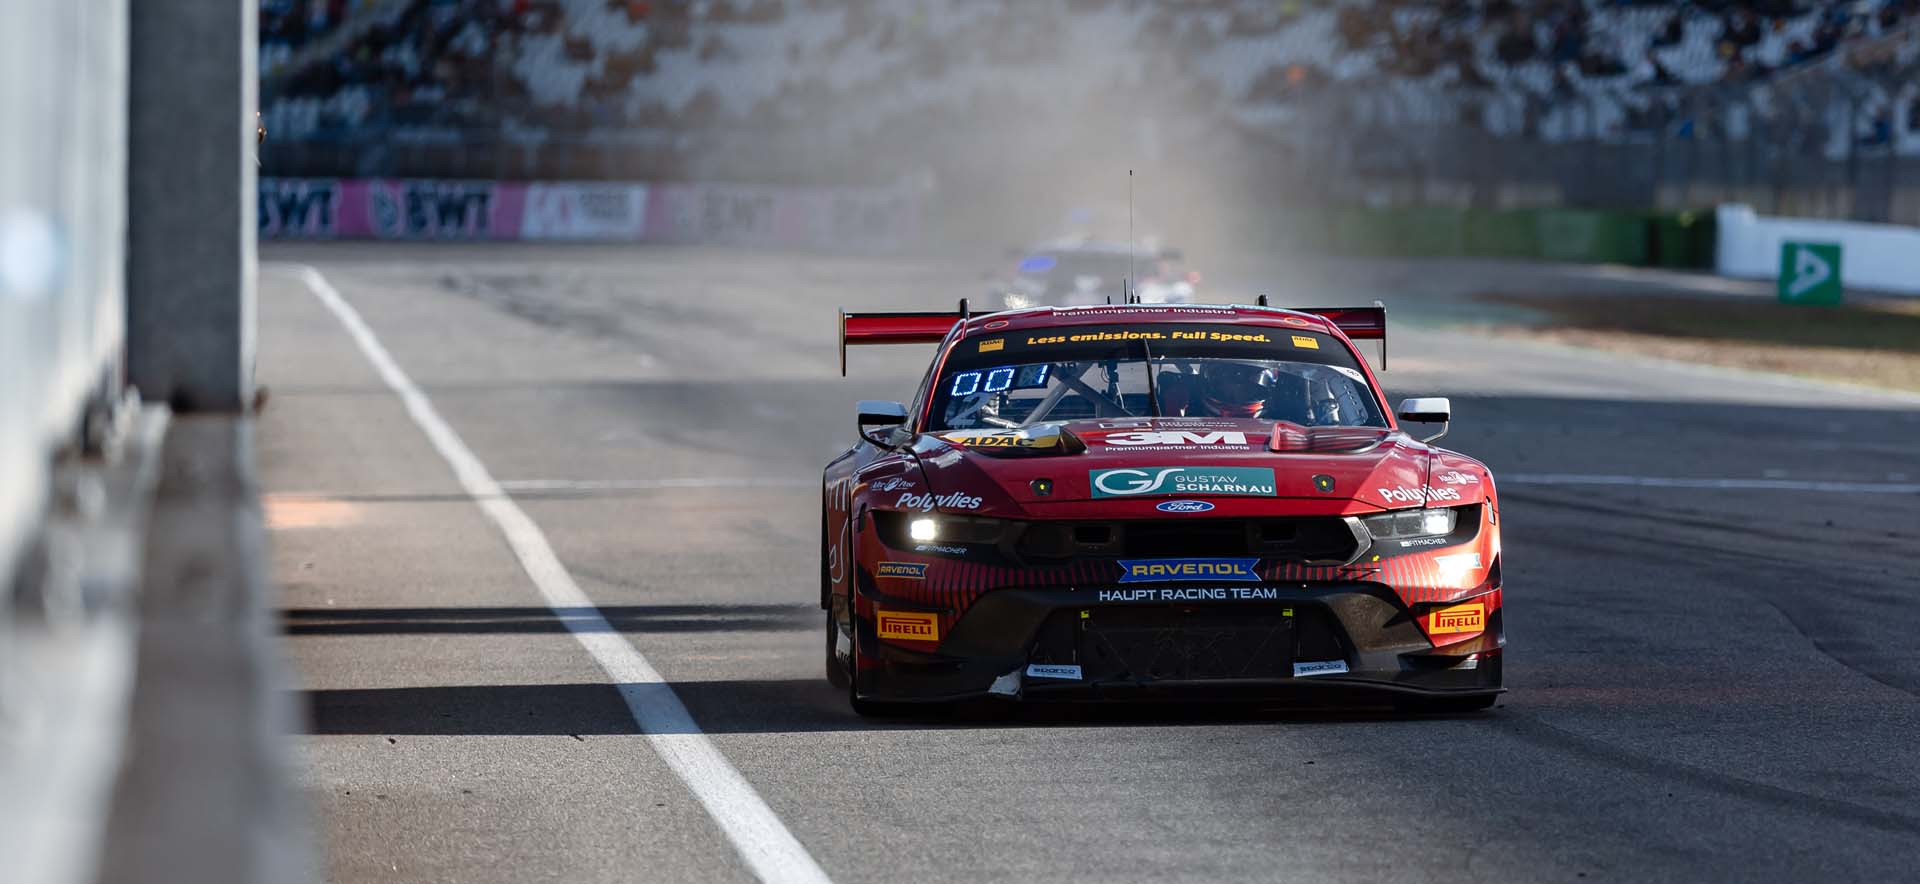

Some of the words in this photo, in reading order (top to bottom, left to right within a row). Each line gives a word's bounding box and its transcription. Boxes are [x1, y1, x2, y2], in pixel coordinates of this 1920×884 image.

[1053, 308, 1168, 316] Premiumpartner
[1027, 336, 1066, 345] Less
[1070, 331, 1166, 342] emissions.
[1172, 331, 1207, 340] Full
[1210, 332, 1271, 343] Speed.
[951, 364, 1048, 396] 001
[961, 436, 1035, 447] ADAC
[1104, 431, 1248, 445] 3M
[1175, 475, 1238, 484] GUSTAV
[1176, 484, 1273, 494] SCHARNAU
[1378, 484, 1461, 505] Polyvlies
[895, 491, 983, 513] Polyvlies
[880, 565, 921, 575] RAVENOL
[1132, 563, 1248, 576] RAVENOL
[1100, 589, 1157, 601] HAUPT
[1161, 588, 1226, 600] RACING
[1231, 587, 1278, 599] TEAM
[881, 616, 932, 635] PIRELLI
[1435, 610, 1481, 628] PIRELLI
